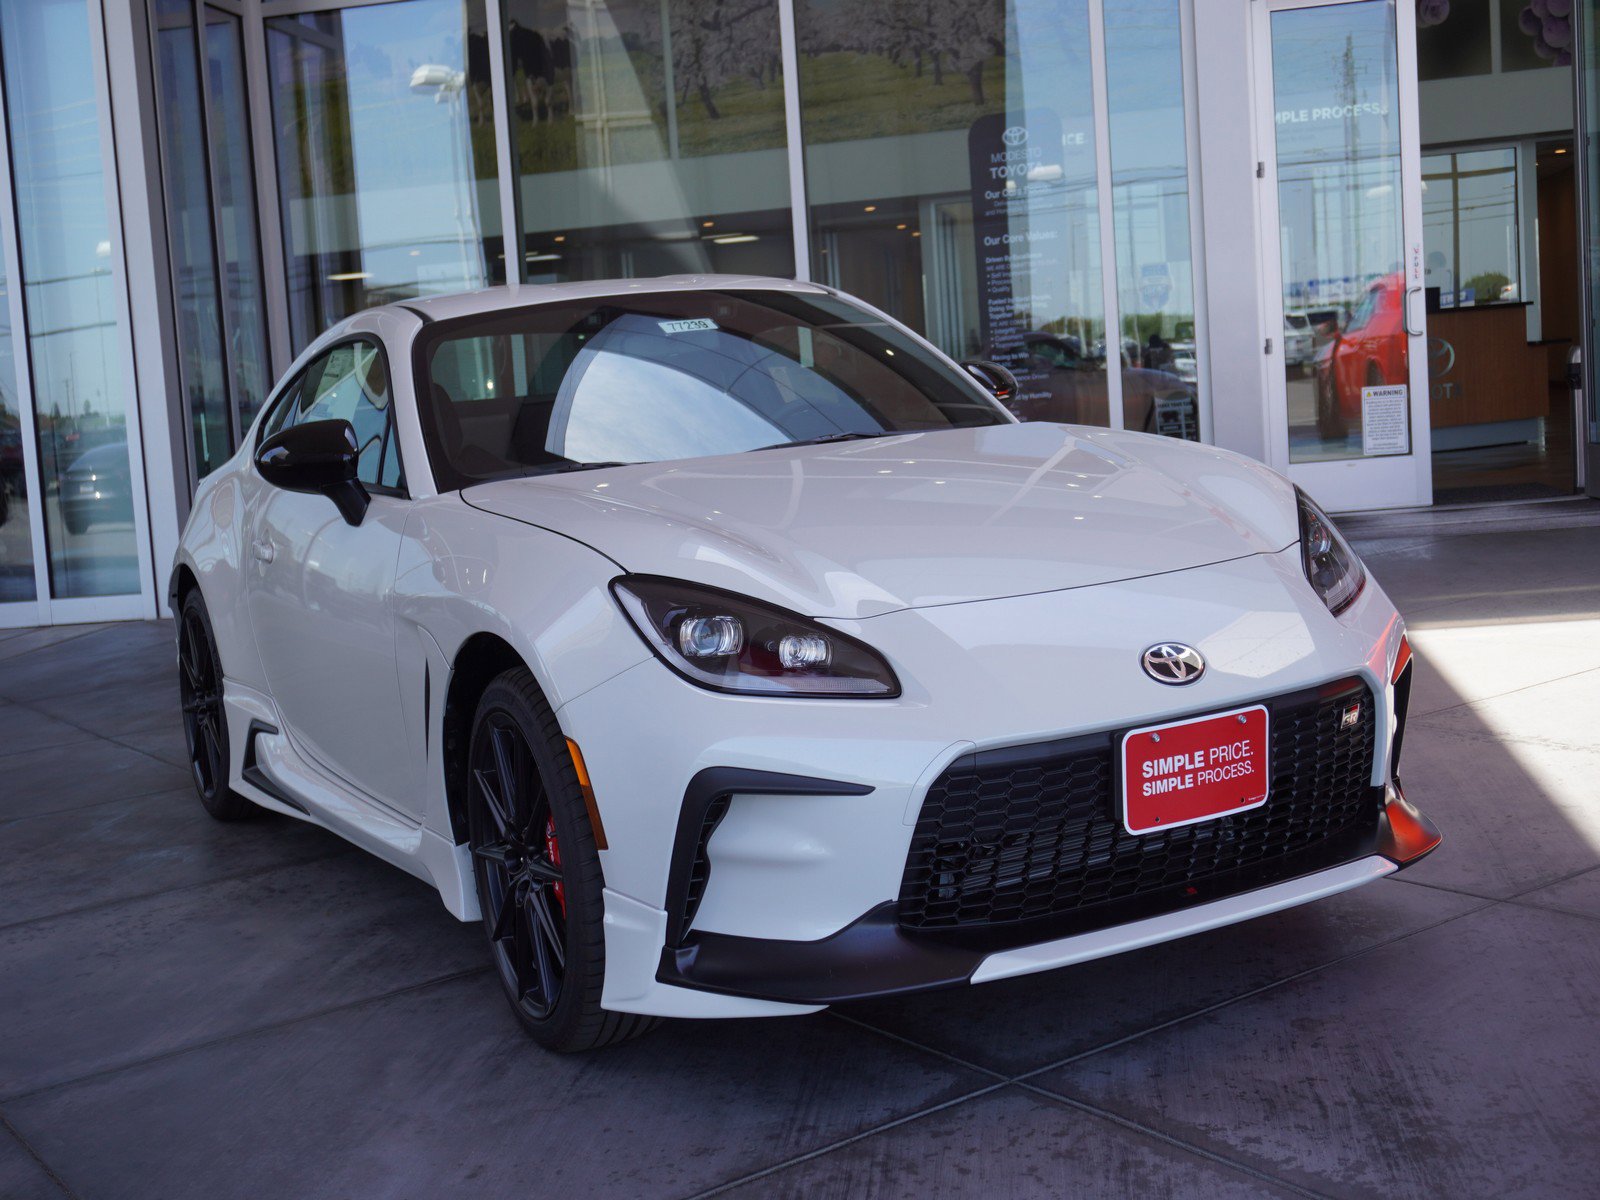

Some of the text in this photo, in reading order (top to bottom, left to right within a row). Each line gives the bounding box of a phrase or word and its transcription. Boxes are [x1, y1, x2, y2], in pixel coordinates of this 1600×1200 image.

[991, 148, 1041, 162] MODESTO
[985, 190, 1000, 199] Our
[984, 236, 1000, 247] Our
[1002, 233, 1024, 244] Core
[1372, 389, 1404, 397] WARNING
[1142, 740, 1254, 778] SIMPLE PRICE.
[1142, 760, 1255, 796] SIMPLE PROCESS.
